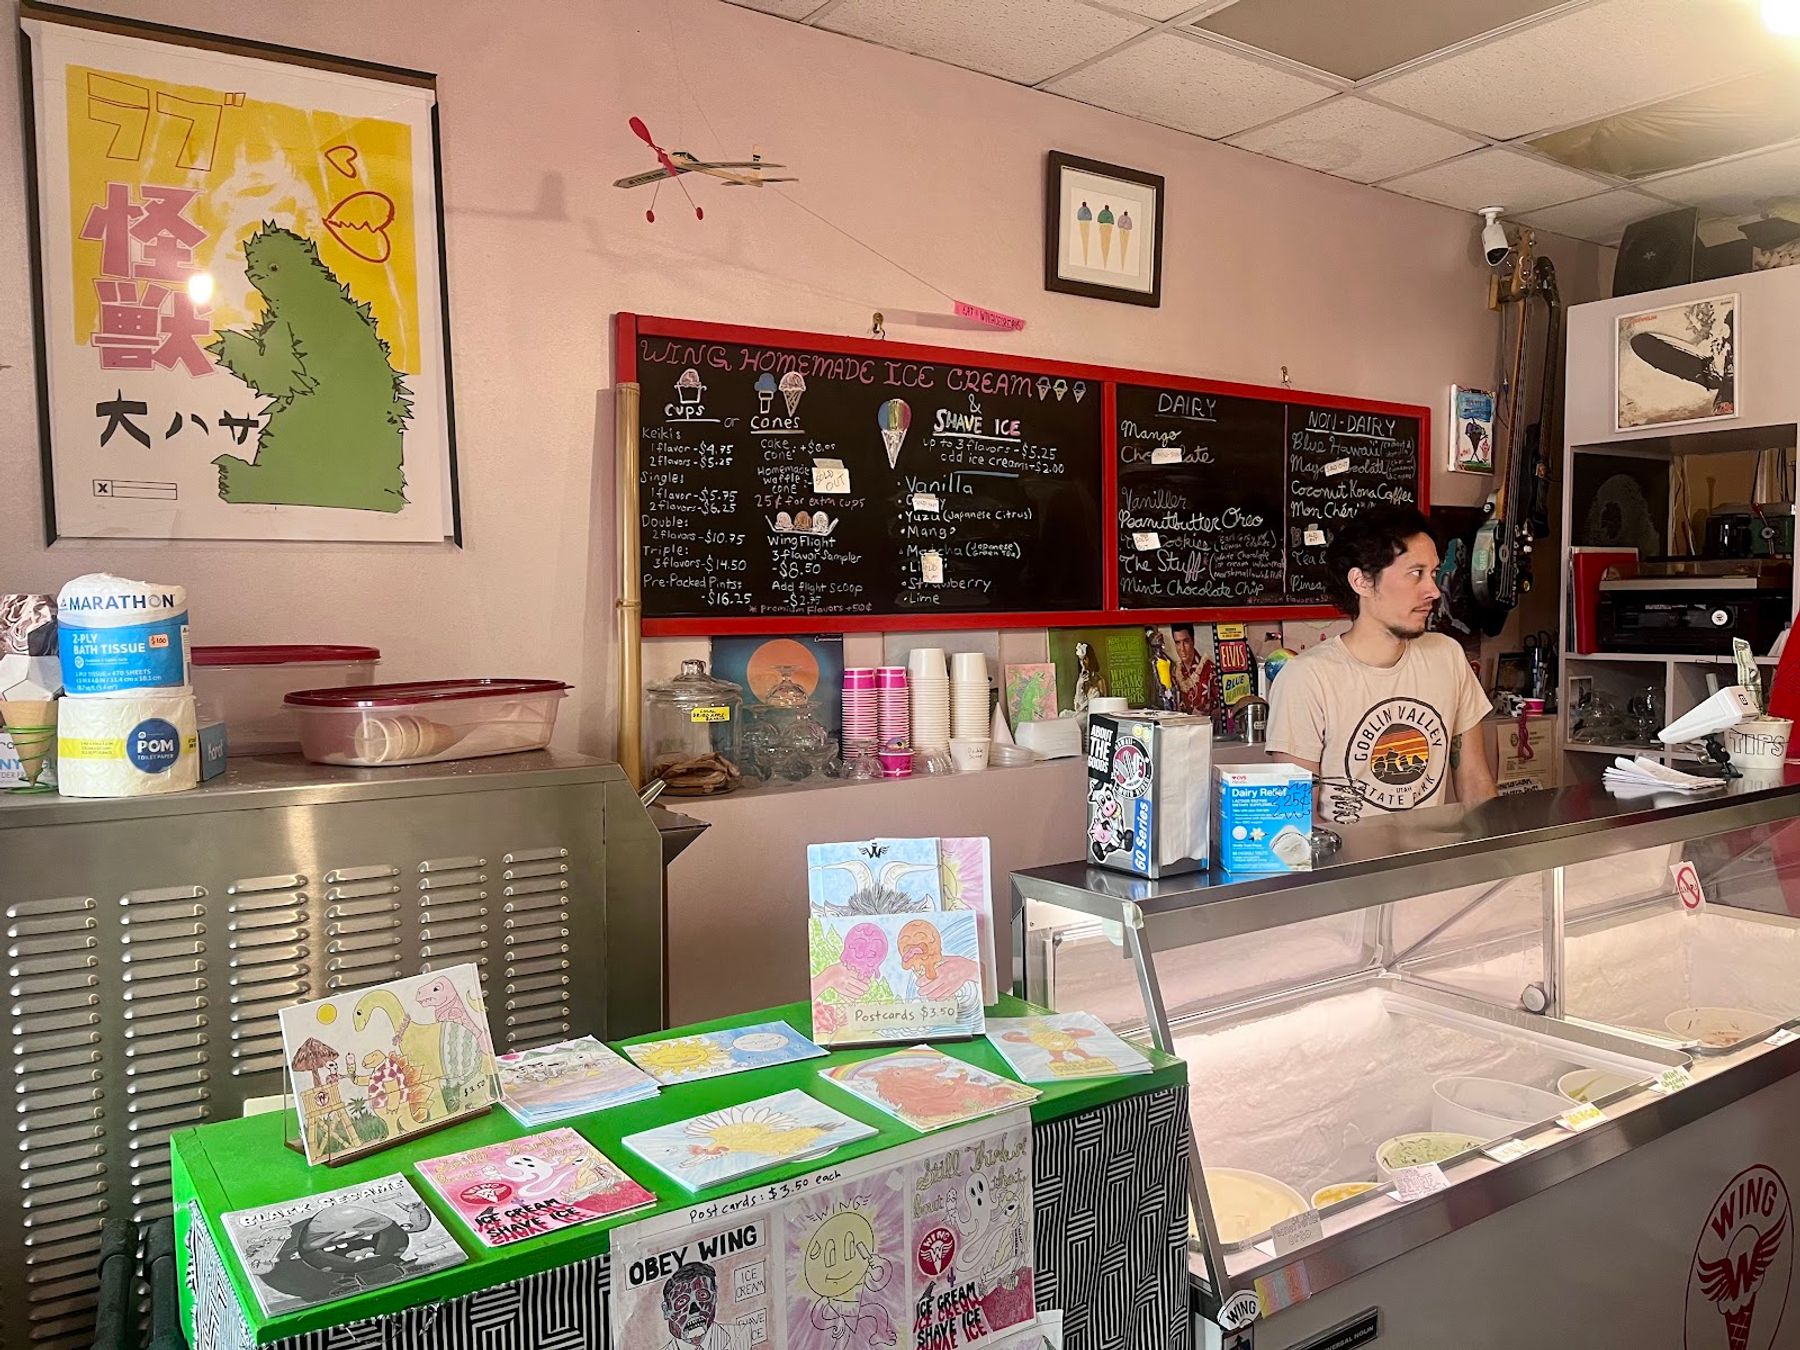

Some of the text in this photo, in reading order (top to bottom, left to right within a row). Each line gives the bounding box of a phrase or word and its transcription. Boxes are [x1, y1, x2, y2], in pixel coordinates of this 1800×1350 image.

[87, 72, 245, 171] ラブ
[641, 340, 1032, 397] WING HOMEMADE ICE CREAM
[968, 393, 983, 414] &
[1158, 393, 1217, 417] DAIRY
[723, 417, 741, 428] or
[934, 409, 1021, 436] SHAVE ICE
[1309, 410, 1395, 437] NON-DAIRY
[1121, 420, 1182, 447] Mango
[940, 439, 952, 448] to
[955, 439, 964, 450] 3
[966, 439, 1011, 454] flavors
[969, 454, 985, 465] ice
[905, 473, 973, 495] Vanilla
[1291, 480, 1414, 505] Coconut Kona Coffee
[785, 496, 805, 506] for
[809, 496, 836, 506] extra
[1291, 501, 1322, 518] Mon
[905, 511, 940, 522] Yuzu
[1222, 507, 1263, 528] Oreo
[767, 534, 836, 552] Wing Flight
[907, 526, 956, 539] Mango
[772, 550, 779, 561] 3
[780, 549, 820, 560] flavor
[1292, 549, 1316, 565] Tea
[1119, 549, 1206, 583] The Stuff
[772, 581, 794, 591] Add
[1120, 578, 1264, 598] Mint Chocolate Chip
[69, 593, 175, 611] MARATHON
[909, 592, 940, 605] Lime
[72, 632, 98, 645] 2-PLY
[73, 642, 146, 656] BATH TISSUE
[1221, 644, 1246, 668] ELVIS
[1226, 675, 1245, 690] BLUE
[1091, 724, 1113, 738] ABOUT
[1354, 705, 1442, 761] GOBLIN VALLEY
[137, 739, 174, 754] POM
[1090, 737, 1112, 761] THE
[1729, 732, 1785, 757] TIPS
[1088, 755, 1108, 773] GOODS
[1232, 787, 1287, 798] Dairy Relief
[1135, 802, 1149, 871] 60 Series
[855, 1008, 955, 1021] Postcards $3.50
[768, 1179, 808, 1200] $3.50
[815, 1170, 841, 1184] each
[239, 1179, 405, 1228] BLACK SESAME
[475, 1199, 560, 1225] ICE CREAM
[814, 1195, 861, 1220] WING
[1711, 1177, 1777, 1241] WING
[487, 1207, 577, 1238] SHAVE ICE
[923, 1230, 950, 1247] WING
[628, 1225, 757, 1285] OBEY WING
[741, 1269, 758, 1283] ICE
[736, 1279, 764, 1298] CREAM
[916, 1281, 976, 1320] ICE CREAM
[1226, 1300, 1256, 1324] WING
[917, 1308, 981, 1346] SHAVE ICE
